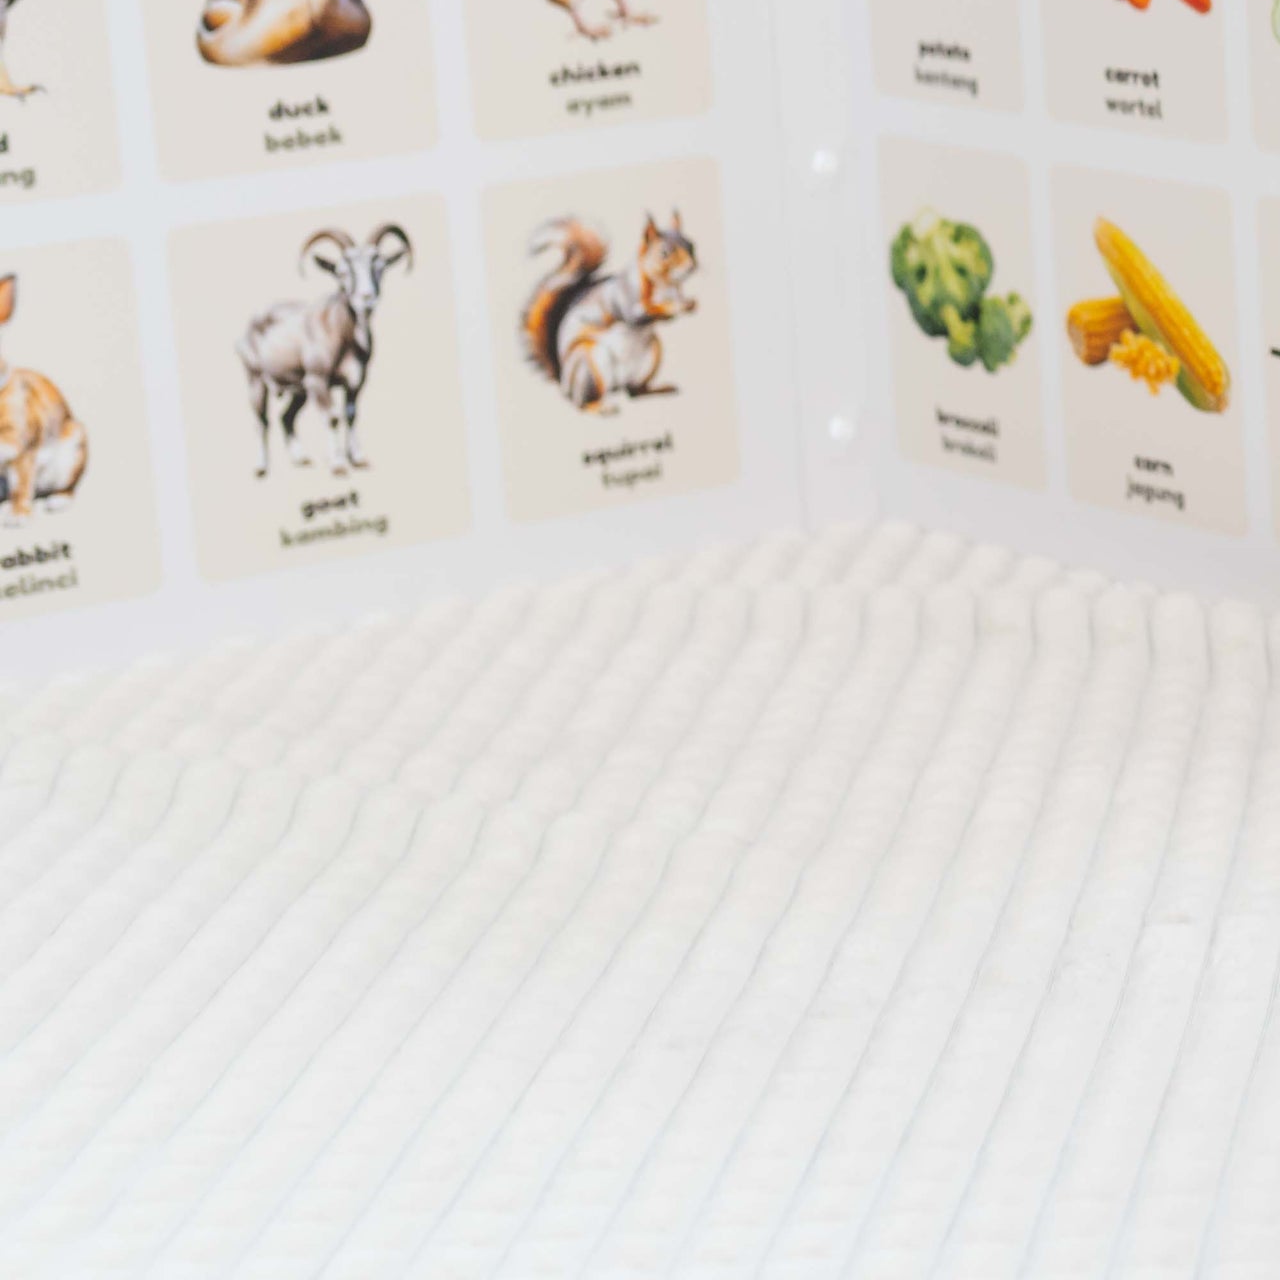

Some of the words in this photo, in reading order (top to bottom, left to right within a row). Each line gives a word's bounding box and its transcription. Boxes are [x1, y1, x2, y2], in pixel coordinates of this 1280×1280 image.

[548, 62, 641, 87] chicken
[1104, 67, 1160, 89] carrot
[268, 96, 330, 121] duck
[1105, 98, 1163, 120] wortel
[263, 125, 343, 154] bebek
[300, 490, 360, 522] goat
[0, 542, 72, 571] abbit
[0, 567, 79, 600] elinci
